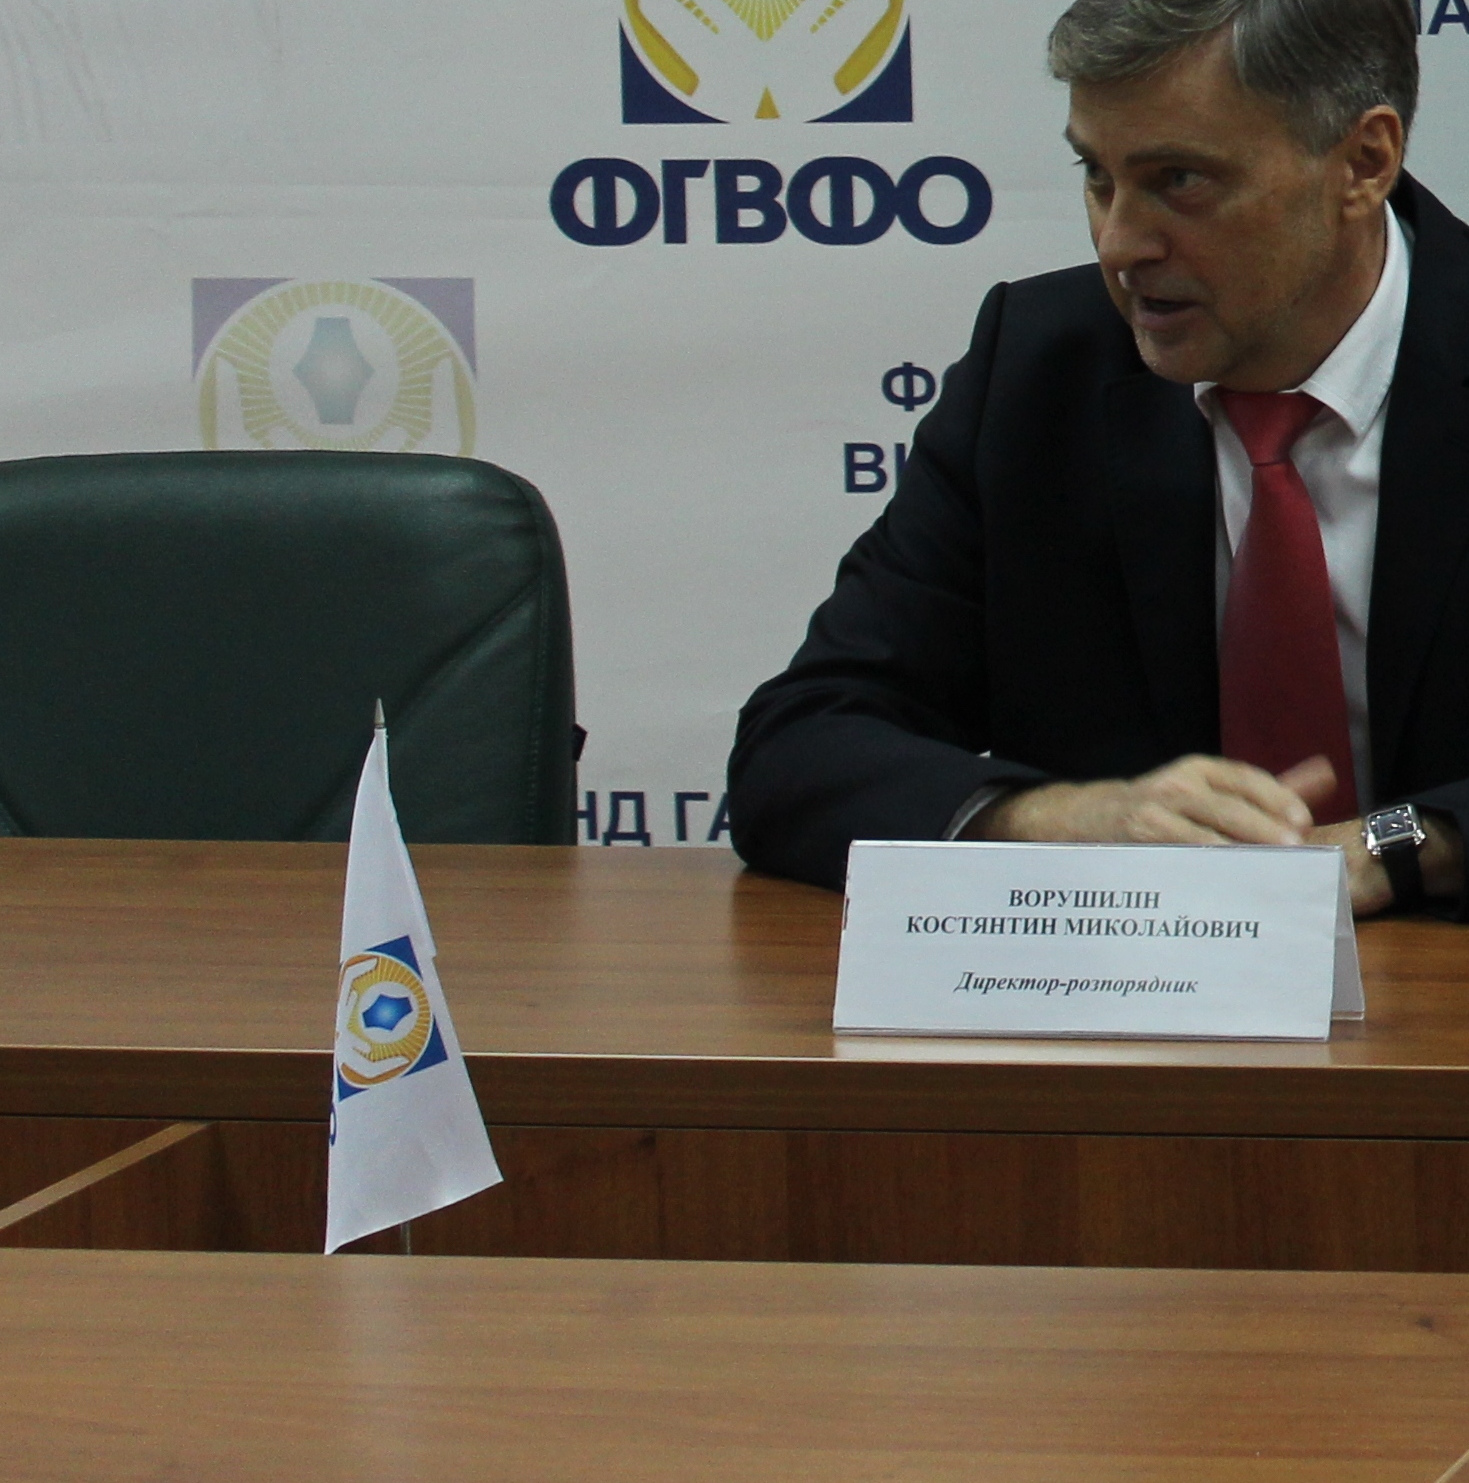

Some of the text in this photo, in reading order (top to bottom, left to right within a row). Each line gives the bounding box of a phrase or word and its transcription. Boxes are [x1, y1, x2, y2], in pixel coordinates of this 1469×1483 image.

[550, 156, 992, 246] ФГВФО
[577, 790, 651, 846] НД
[1007, 889, 1161, 909] ВОРУШИЛІН
[905, 914, 1260, 939] КОСТЯНТИН МИКОЛАЙОВИЧ
[952, 971, 1197, 997] Директор-розпорядник
